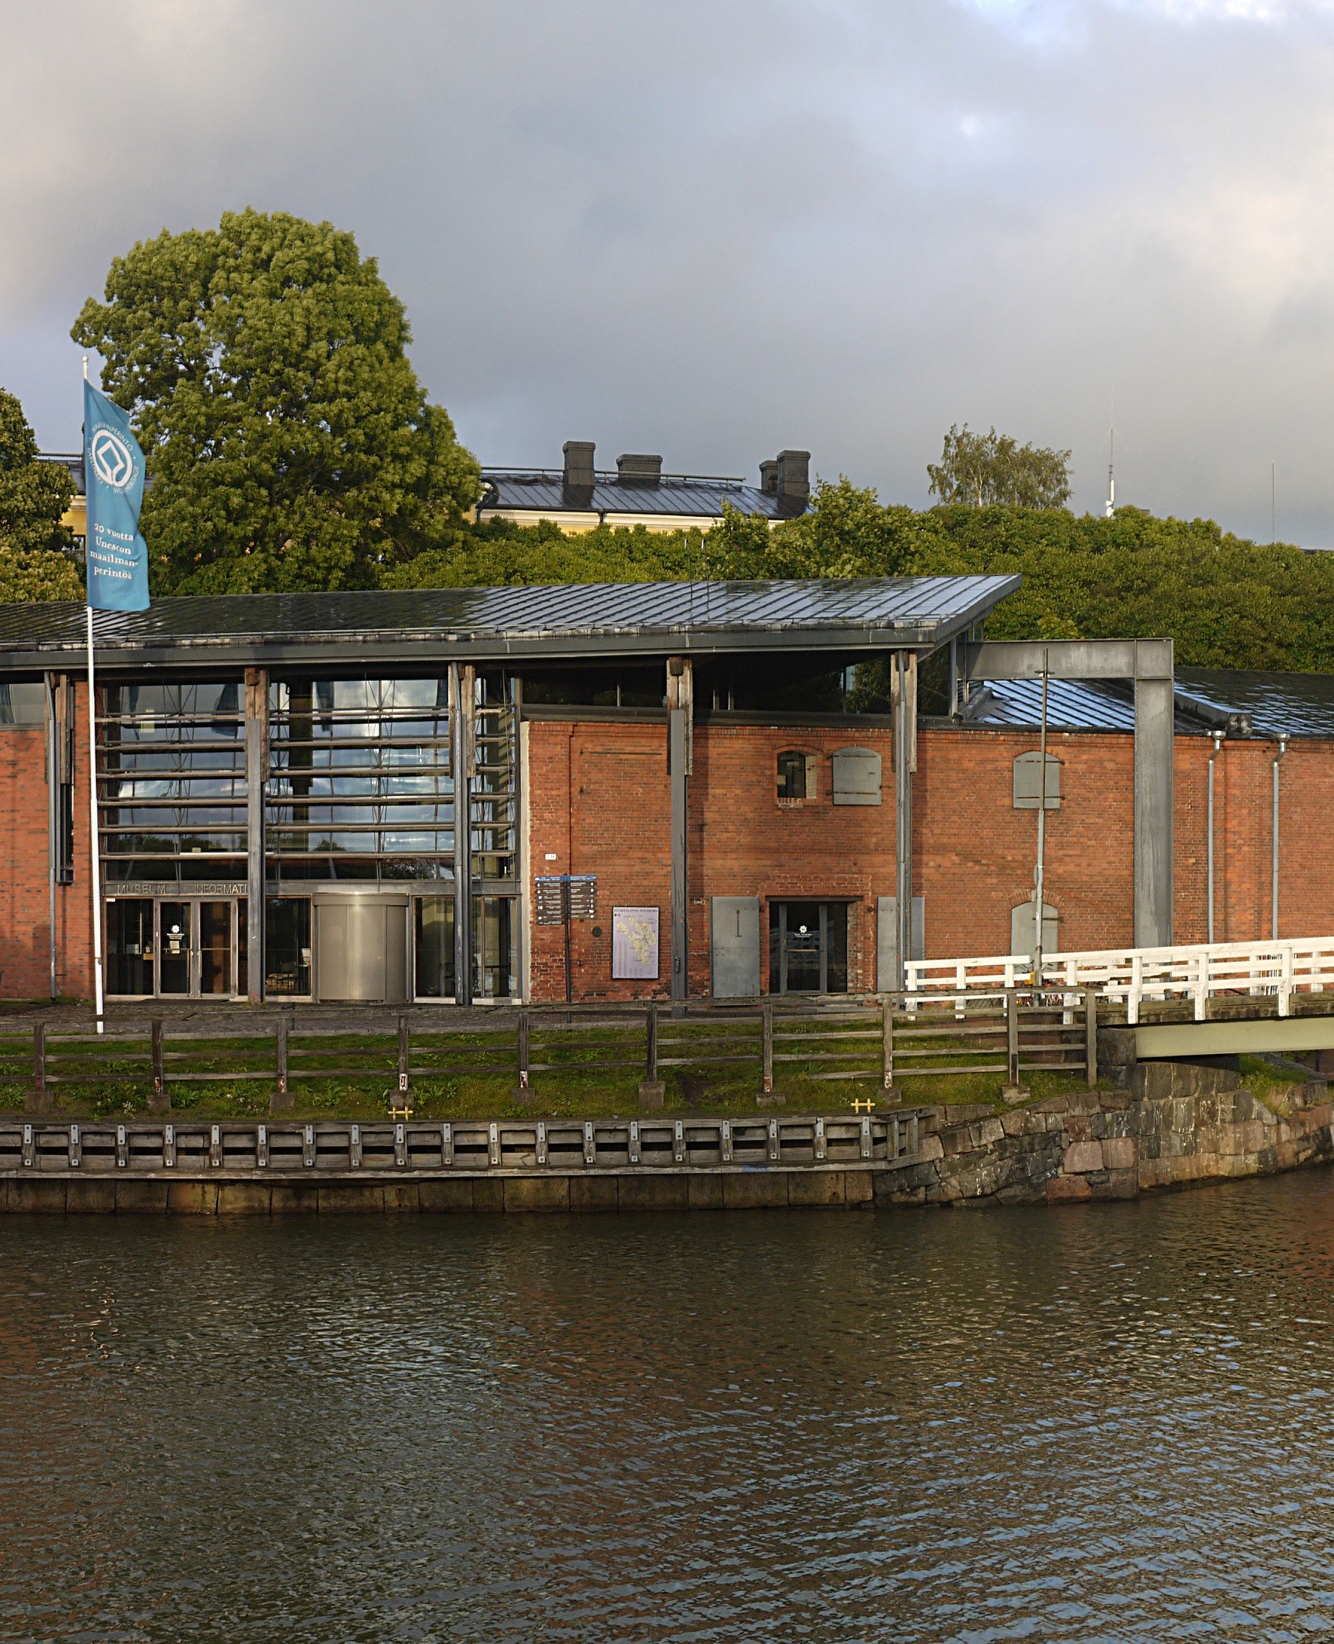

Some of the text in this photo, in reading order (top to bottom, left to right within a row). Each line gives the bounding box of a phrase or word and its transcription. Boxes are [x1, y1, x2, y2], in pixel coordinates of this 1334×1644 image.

[94, 523, 134, 541] 20 vuotta
[95, 536, 131, 555] Unescon
[90, 550, 139, 567] maailman-
[94, 566, 132, 580] perintöä
[117, 884, 166, 895] MUSEUM
